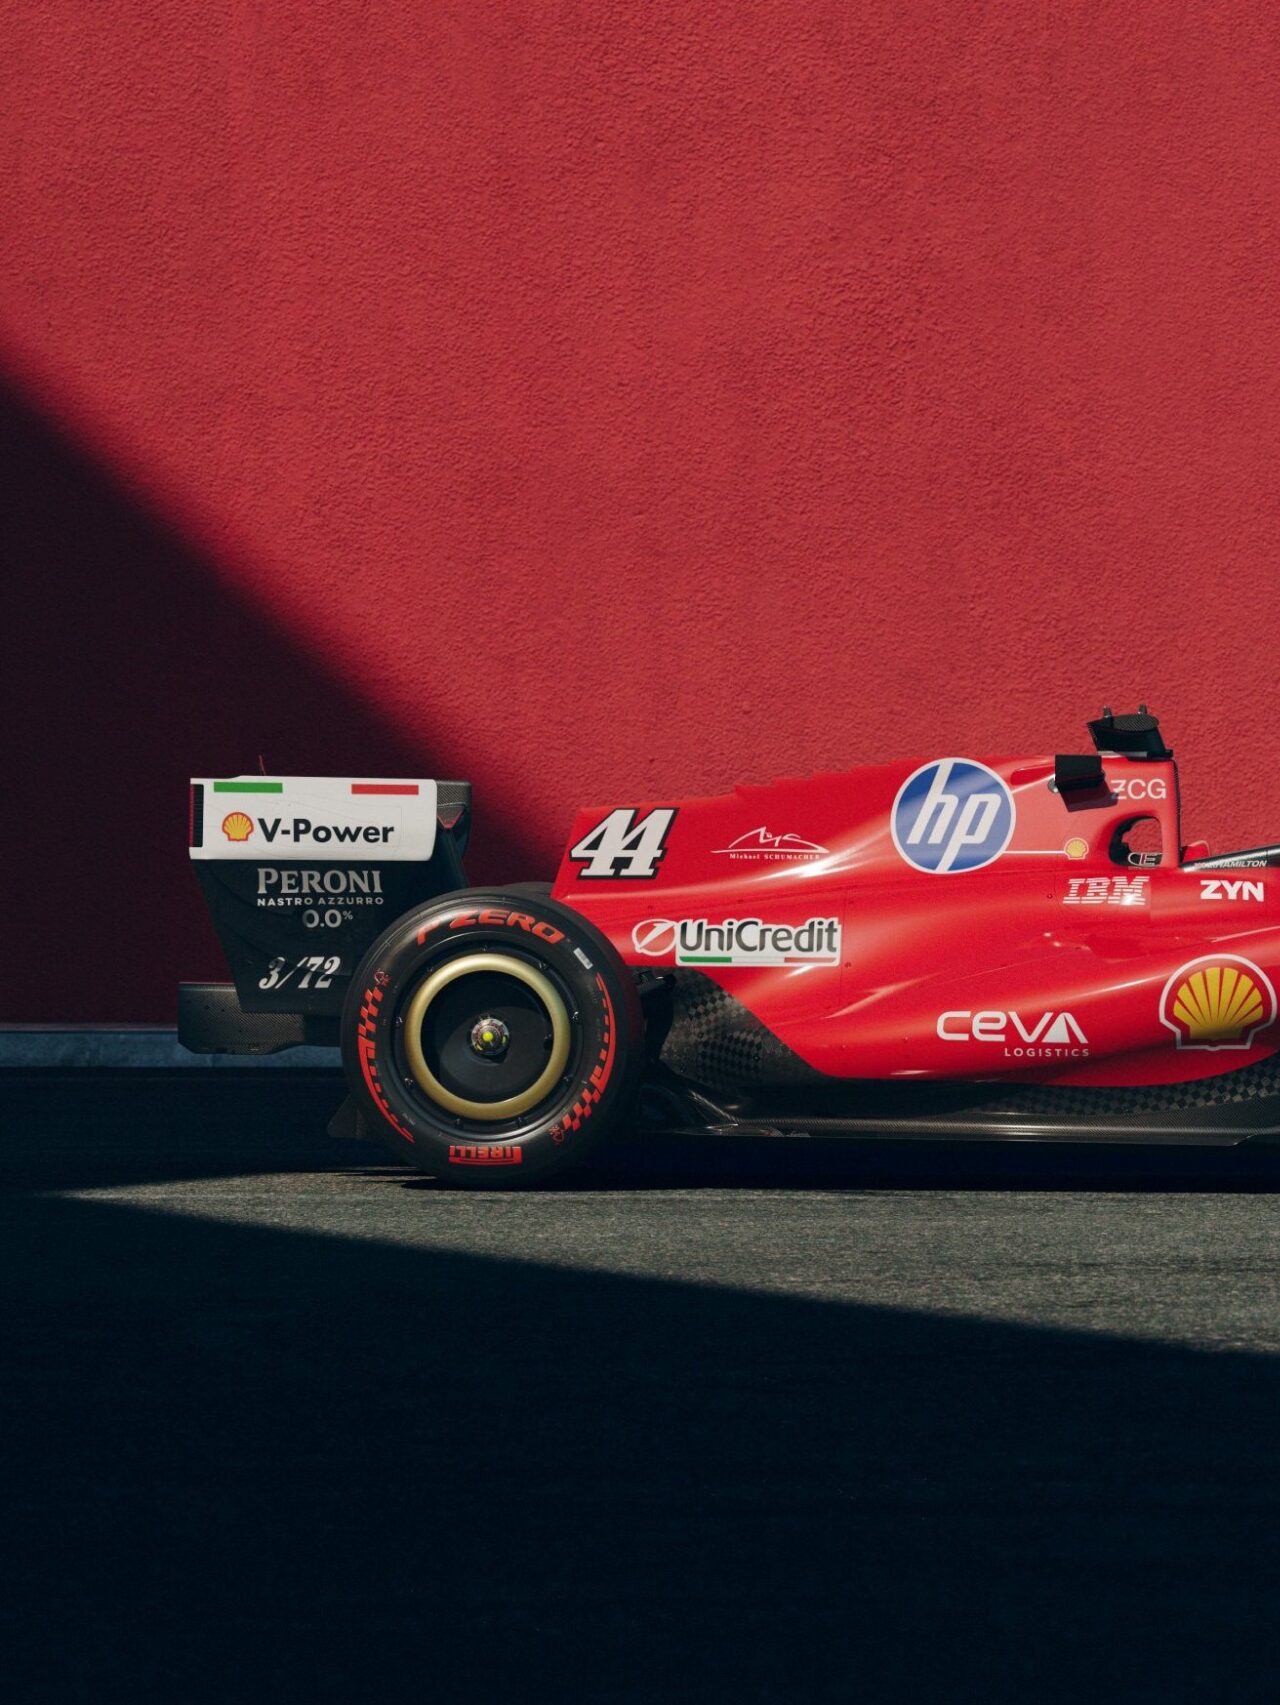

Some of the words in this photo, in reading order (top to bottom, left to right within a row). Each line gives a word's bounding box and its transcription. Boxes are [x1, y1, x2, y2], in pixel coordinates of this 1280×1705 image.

[906, 761, 1000, 872] hp
[257, 818, 395, 843] V-Power
[569, 807, 680, 880] 44
[729, 852, 760, 860] Michael
[257, 868, 383, 894] PERONI
[1062, 875, 1151, 906] IBM
[1200, 880, 1264, 902] ZYN
[257, 897, 313, 907] NASTRO
[318, 896, 384, 905] AZZURRO
[449, 908, 568, 946] ZERO
[680, 920, 838, 953] UniCredit
[258, 956, 341, 989] 3/72
[1004, 1048, 1090, 1057] LOGISTICS
[448, 1145, 523, 1165] PIRELLI
